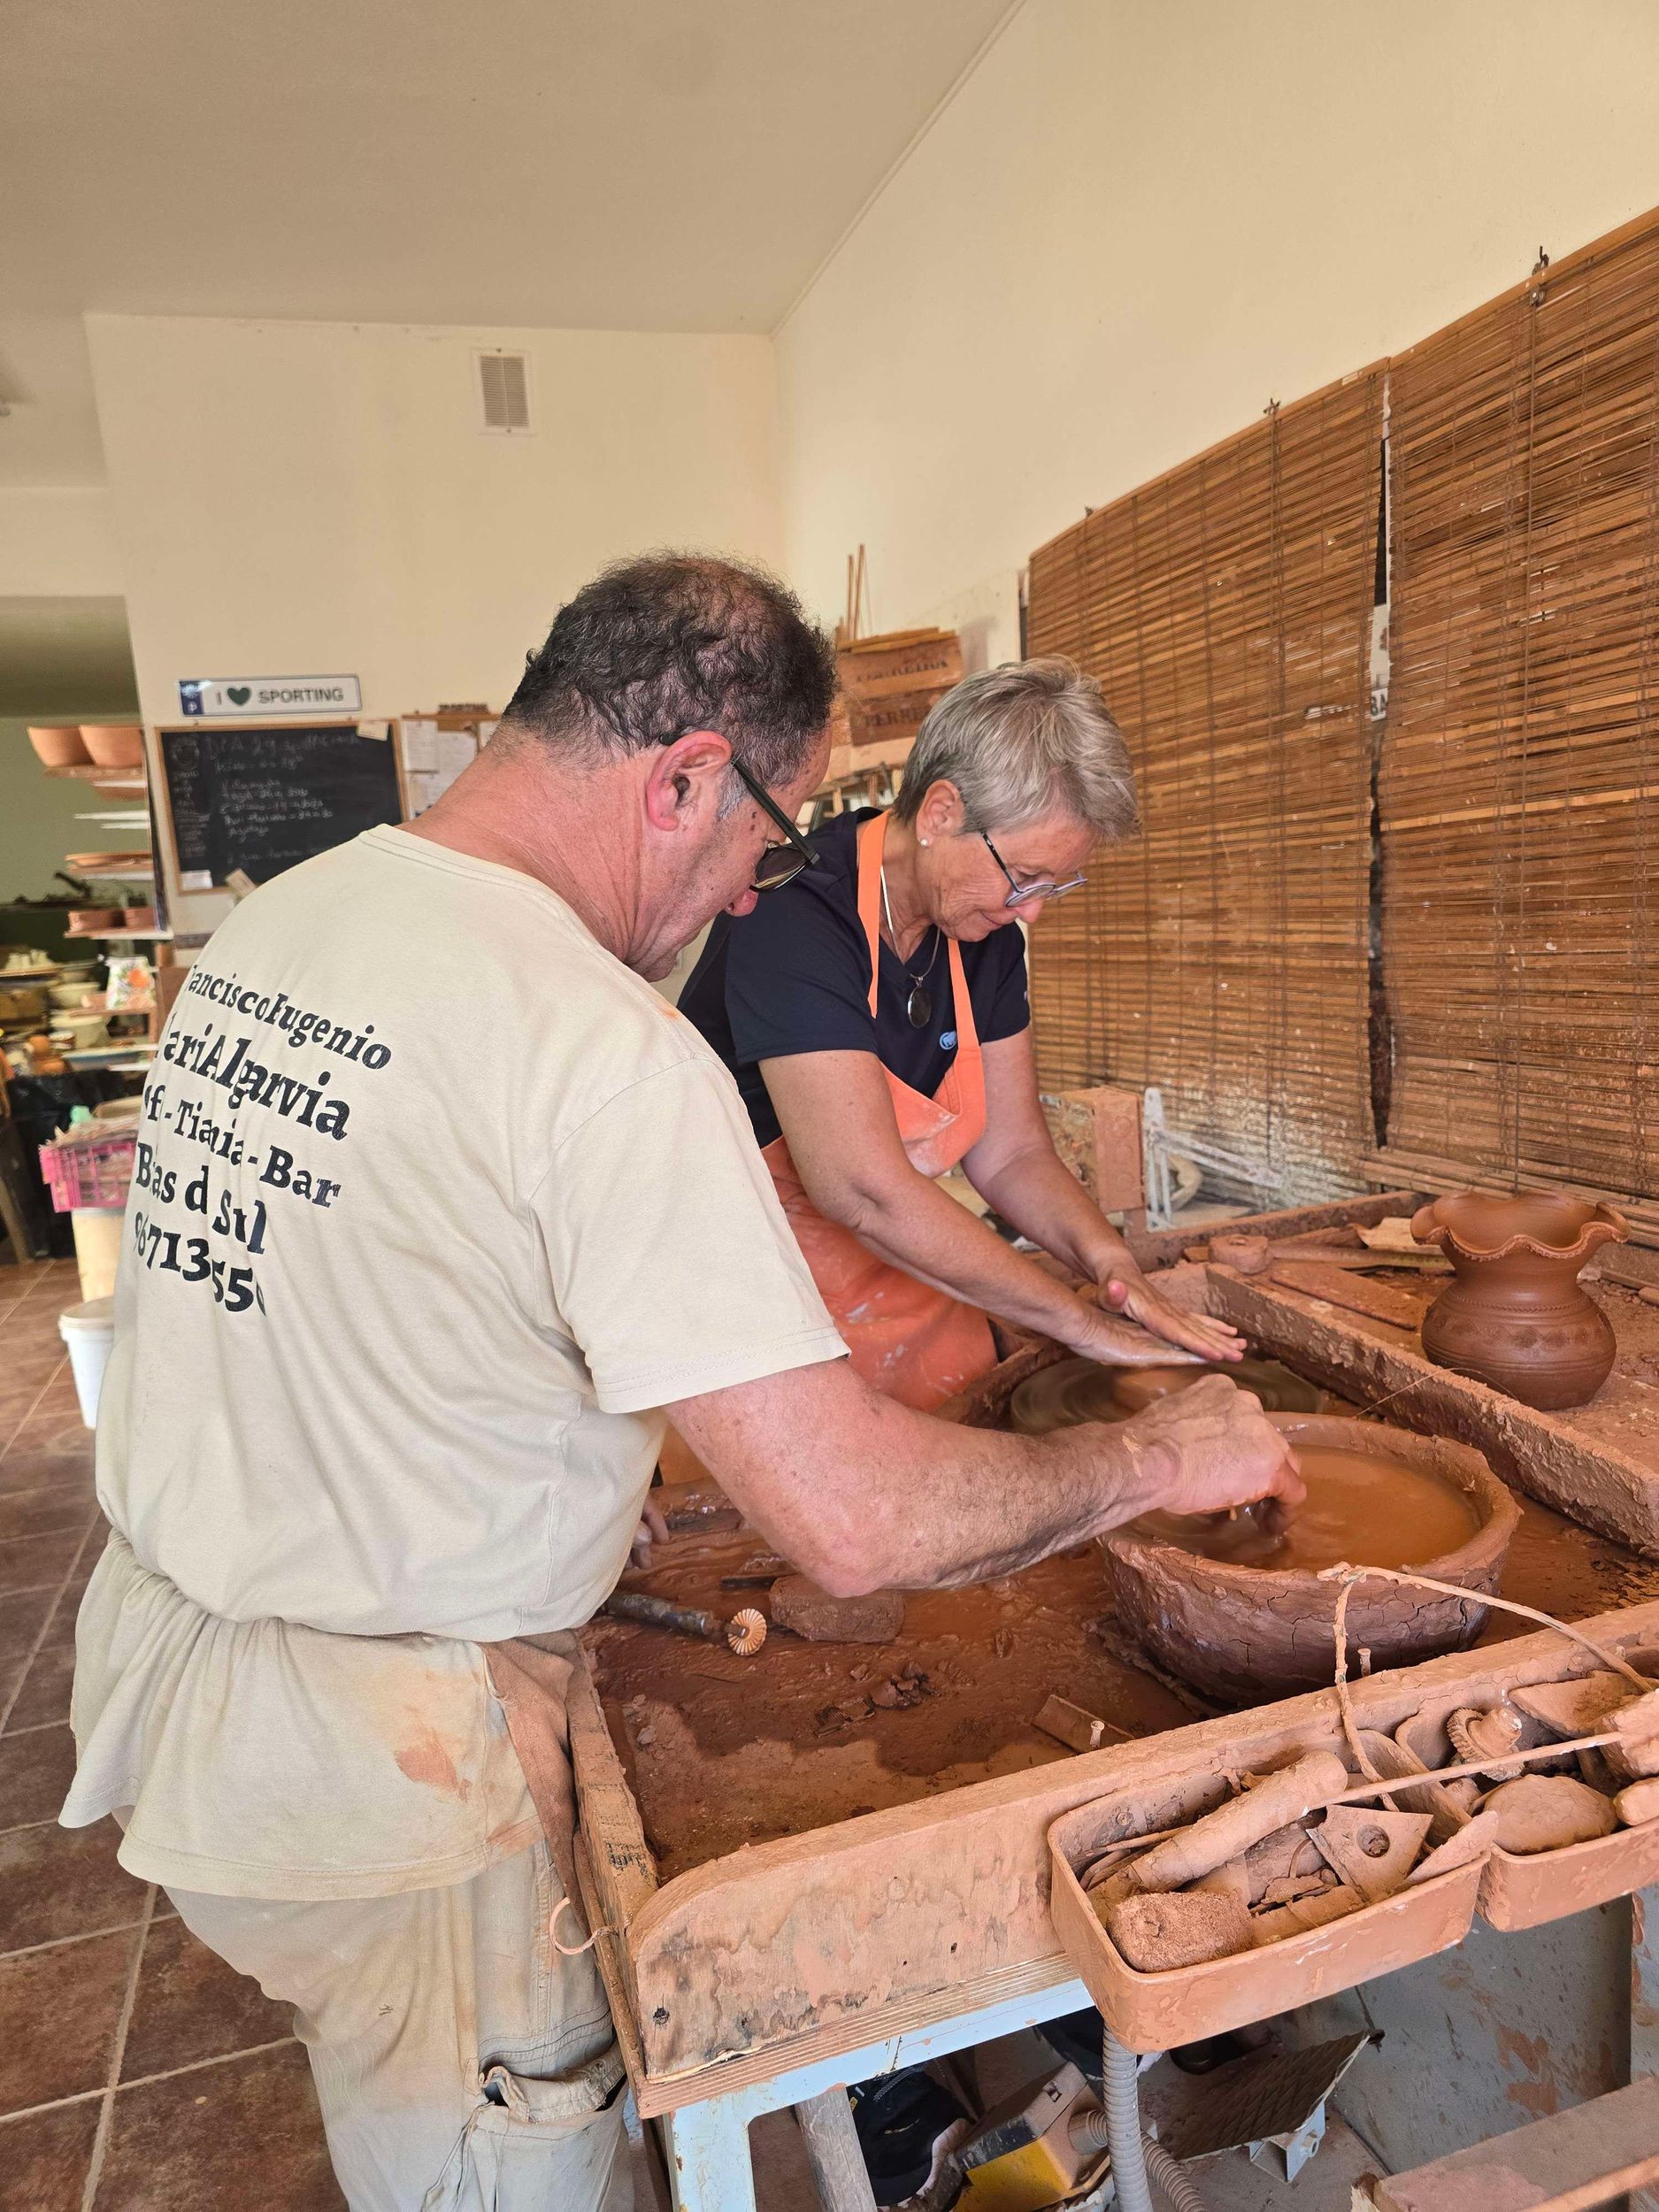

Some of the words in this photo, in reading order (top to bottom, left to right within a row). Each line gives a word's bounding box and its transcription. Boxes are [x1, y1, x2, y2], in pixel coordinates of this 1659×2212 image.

[215, 692, 222, 705] I
[257, 687, 344, 704] SPORTING
[185, 964, 392, 1070] anciscoEugenio
[156, 1014, 350, 1141] ariAlgarvia
